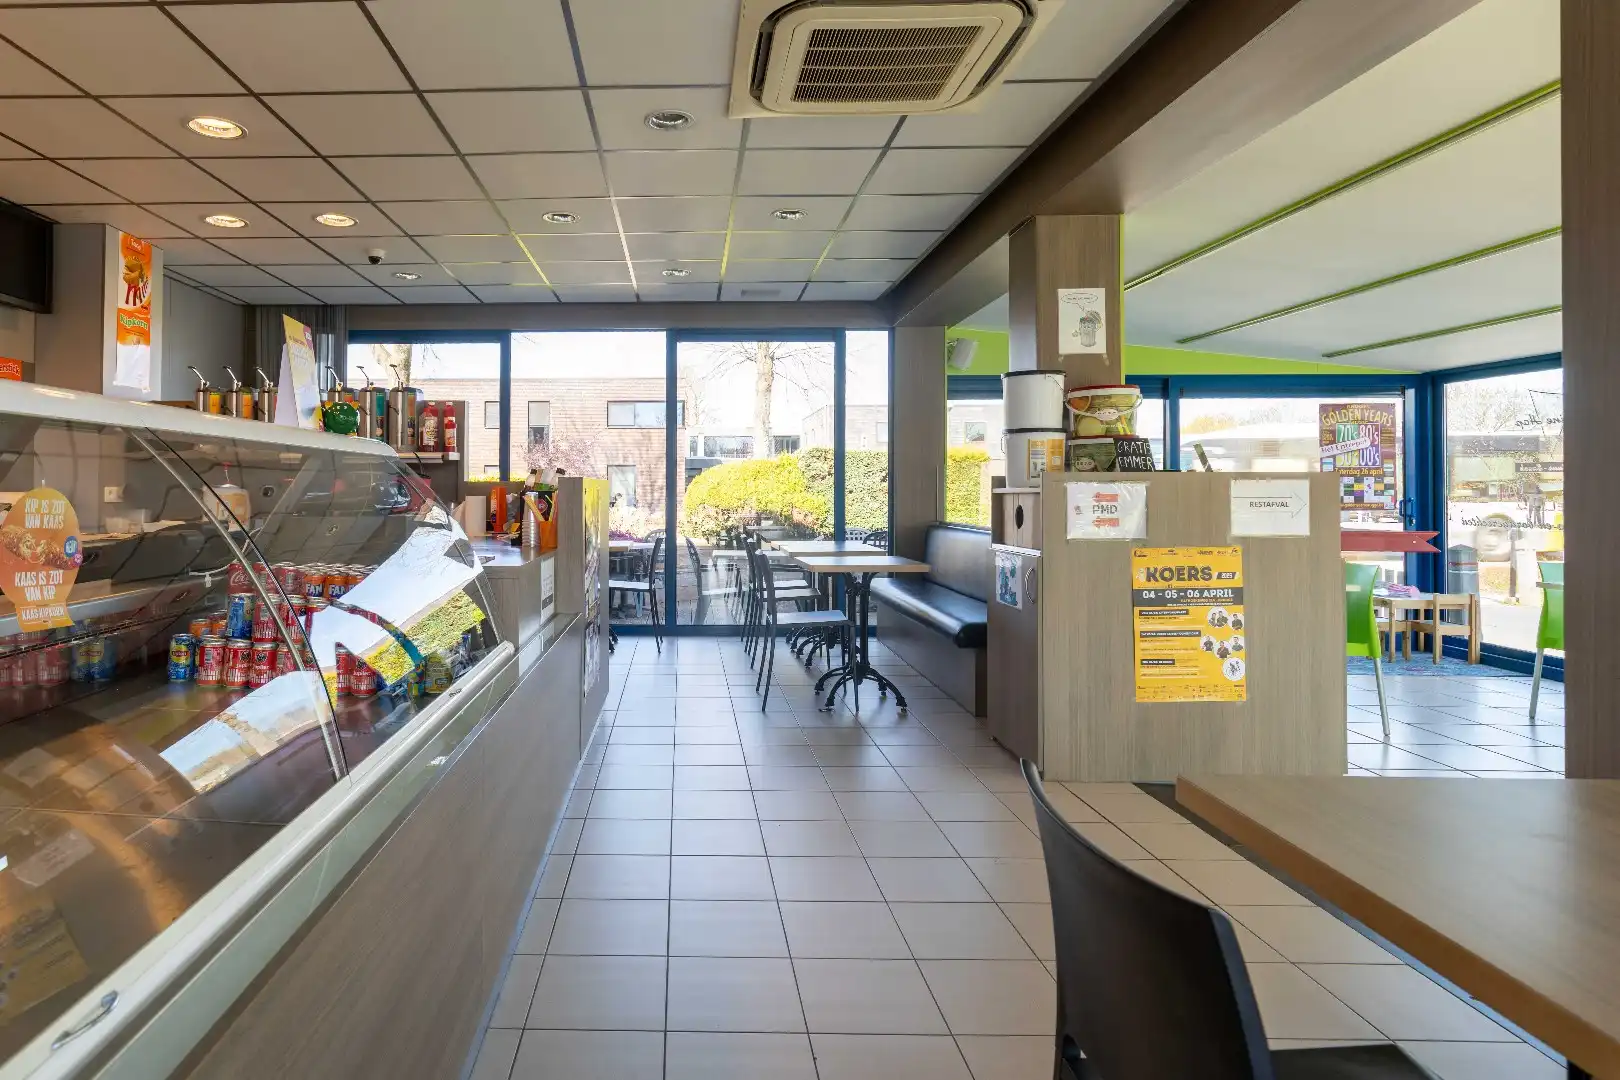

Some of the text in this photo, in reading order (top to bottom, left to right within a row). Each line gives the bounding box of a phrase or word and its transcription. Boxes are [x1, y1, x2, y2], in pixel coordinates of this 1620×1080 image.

[119, 313, 148, 330] Kipkorn
[1321, 408, 1394, 427] GOLDEN YEARS
[1337, 424, 1358, 443] 70's
[1359, 424, 1379, 445] 80's
[1117, 439, 1152, 455] GRATIS
[1118, 455, 1155, 472] EMMER
[1359, 446, 1380, 467] 00's
[1361, 467, 1369, 475] 26
[1369, 467, 1383, 477] april
[25, 499, 66, 513] KIP IS ZOT
[1093, 504, 1118, 514] PMD
[25, 513, 65, 529] VAN KAAS
[14, 569, 64, 587] KAAS IS ZOT
[1145, 565, 1213, 582] KOERS
[25, 585, 57, 602] VAN KIP
[1142, 590, 1156, 599] 04
[1165, 590, 1178, 599] 05
[1187, 589, 1200, 598] 06
[1202, 588, 1234, 598] APRIL
